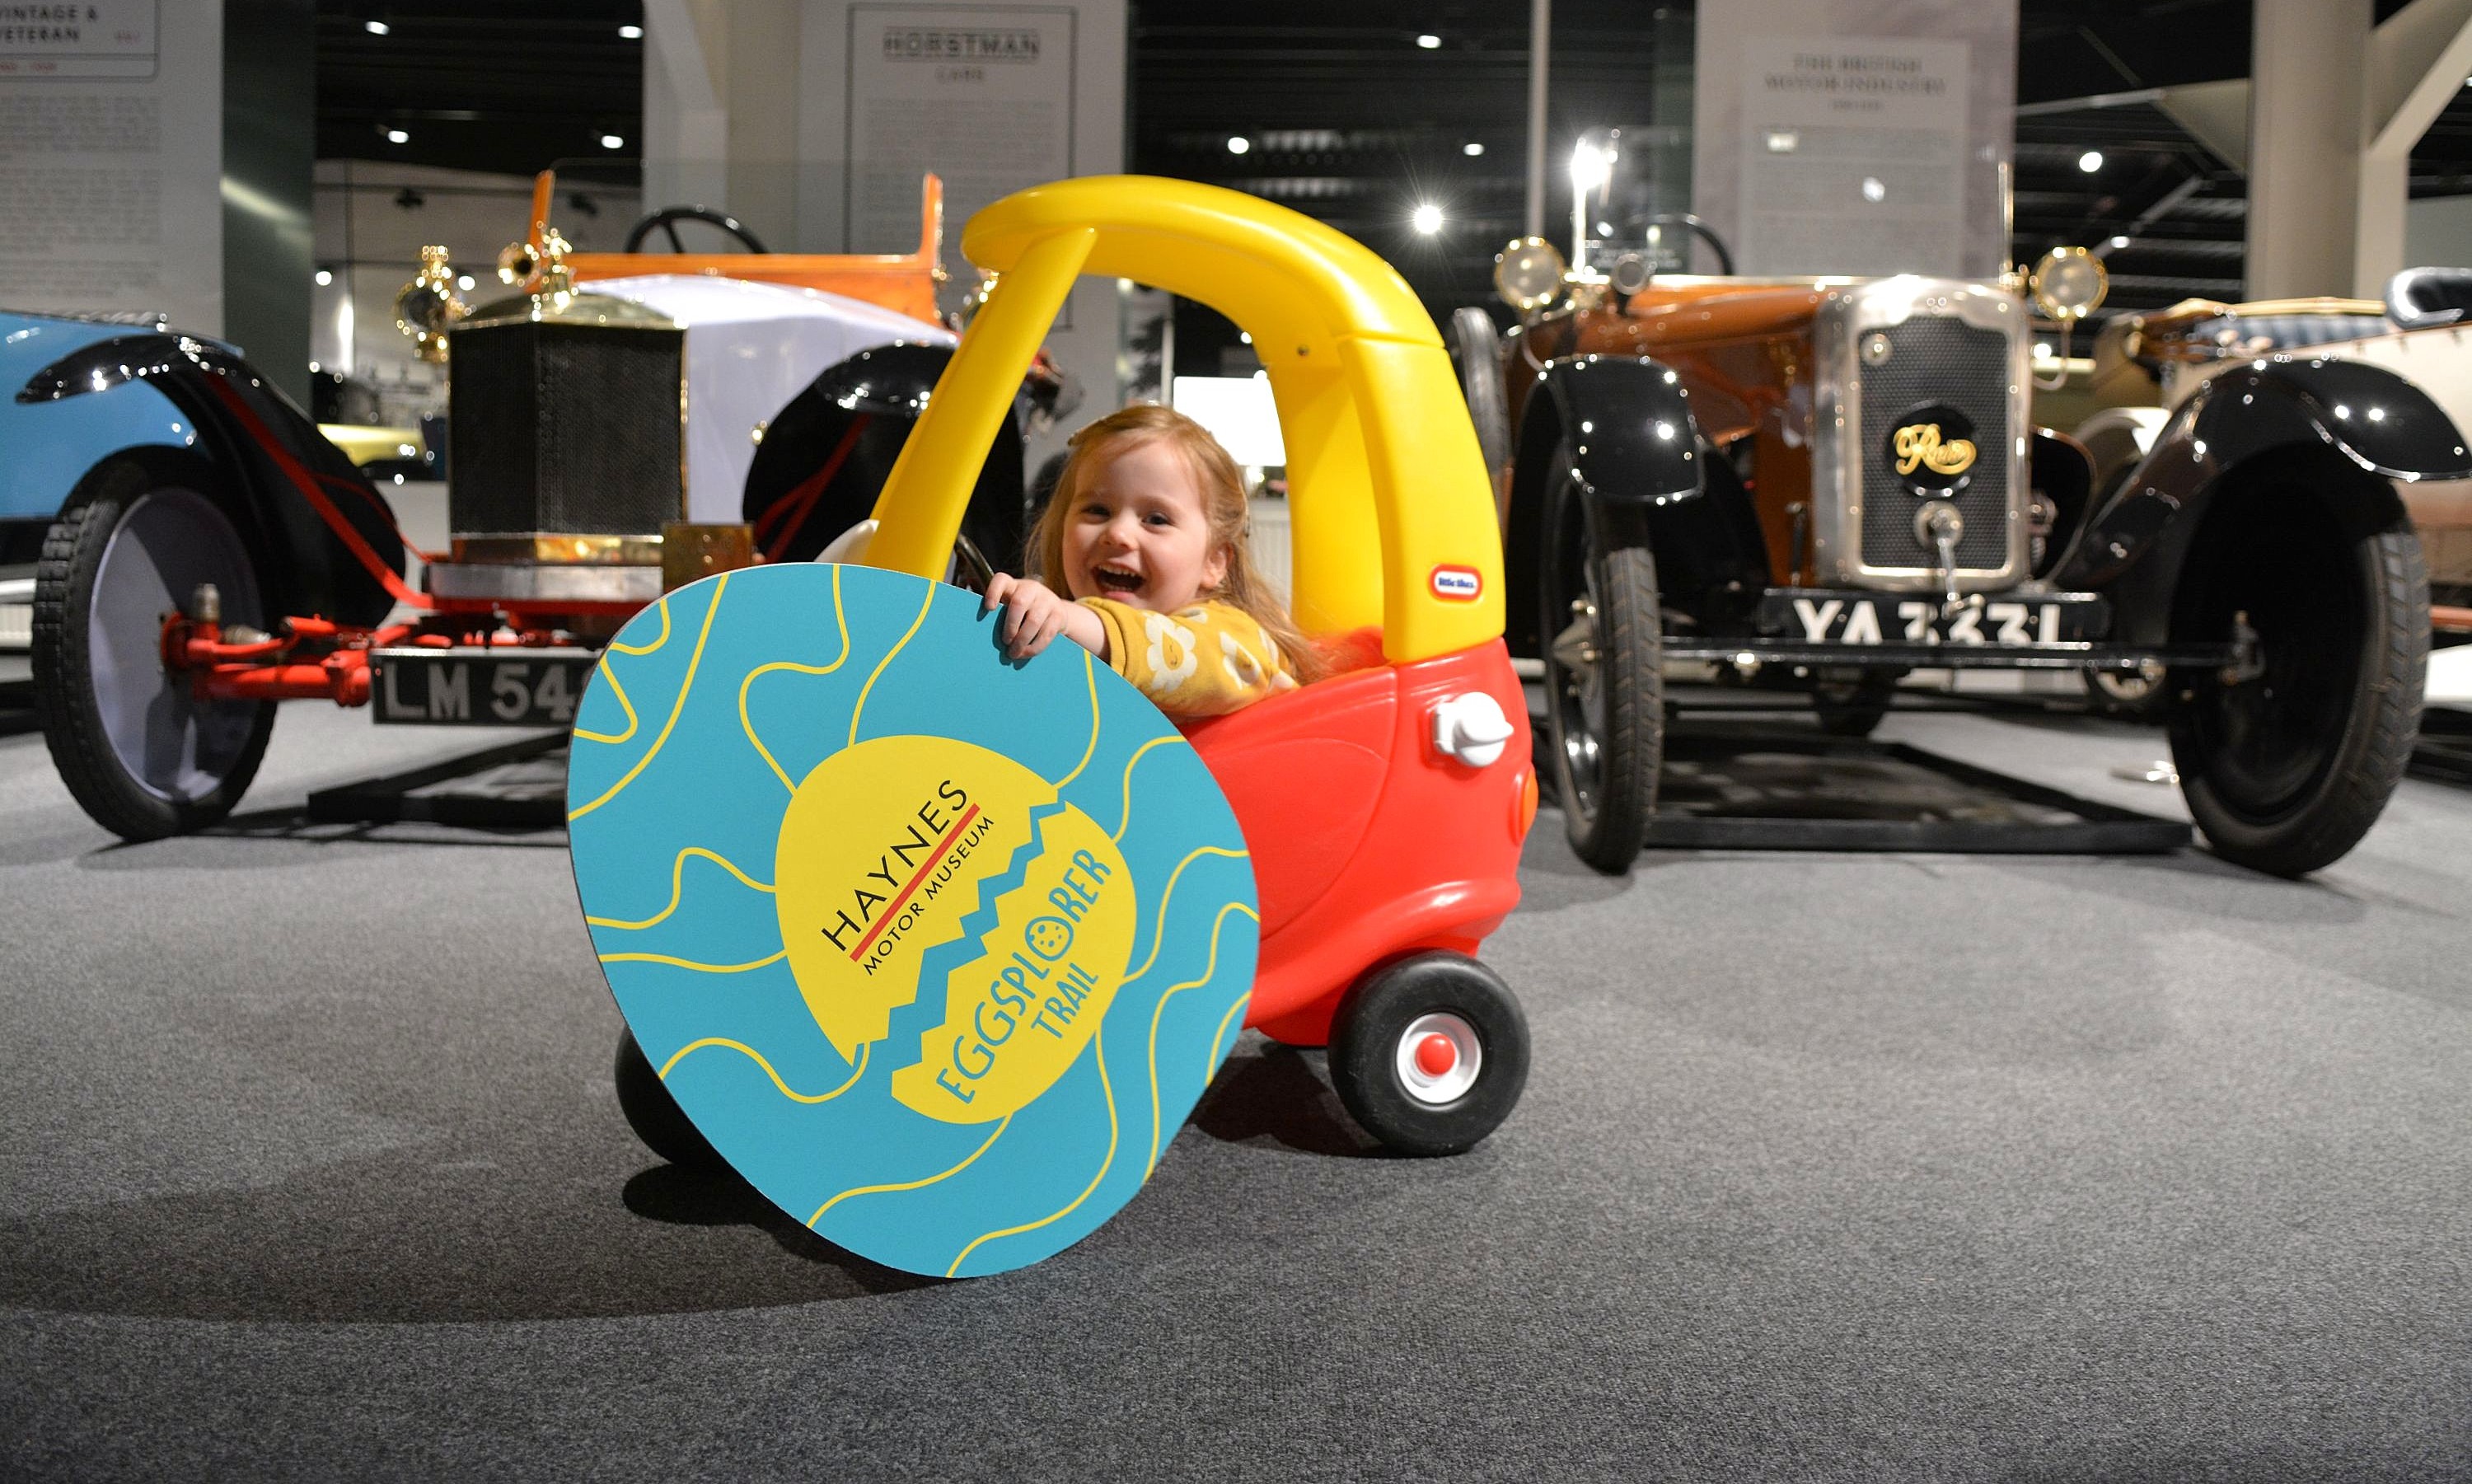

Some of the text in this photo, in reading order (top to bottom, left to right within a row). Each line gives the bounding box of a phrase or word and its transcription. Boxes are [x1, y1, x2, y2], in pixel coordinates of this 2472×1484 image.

[0, 26, 80, 42] ETERAN
[1793, 599, 1883, 646] YA
[383, 662, 588, 721] LM 54
[821, 779, 967, 952] HAYNES
[863, 817, 995, 976] MOTOR MUSEUM
[936, 849, 1112, 1105] EGGSPLORER
[1030, 962, 1099, 1039] TRAIL
